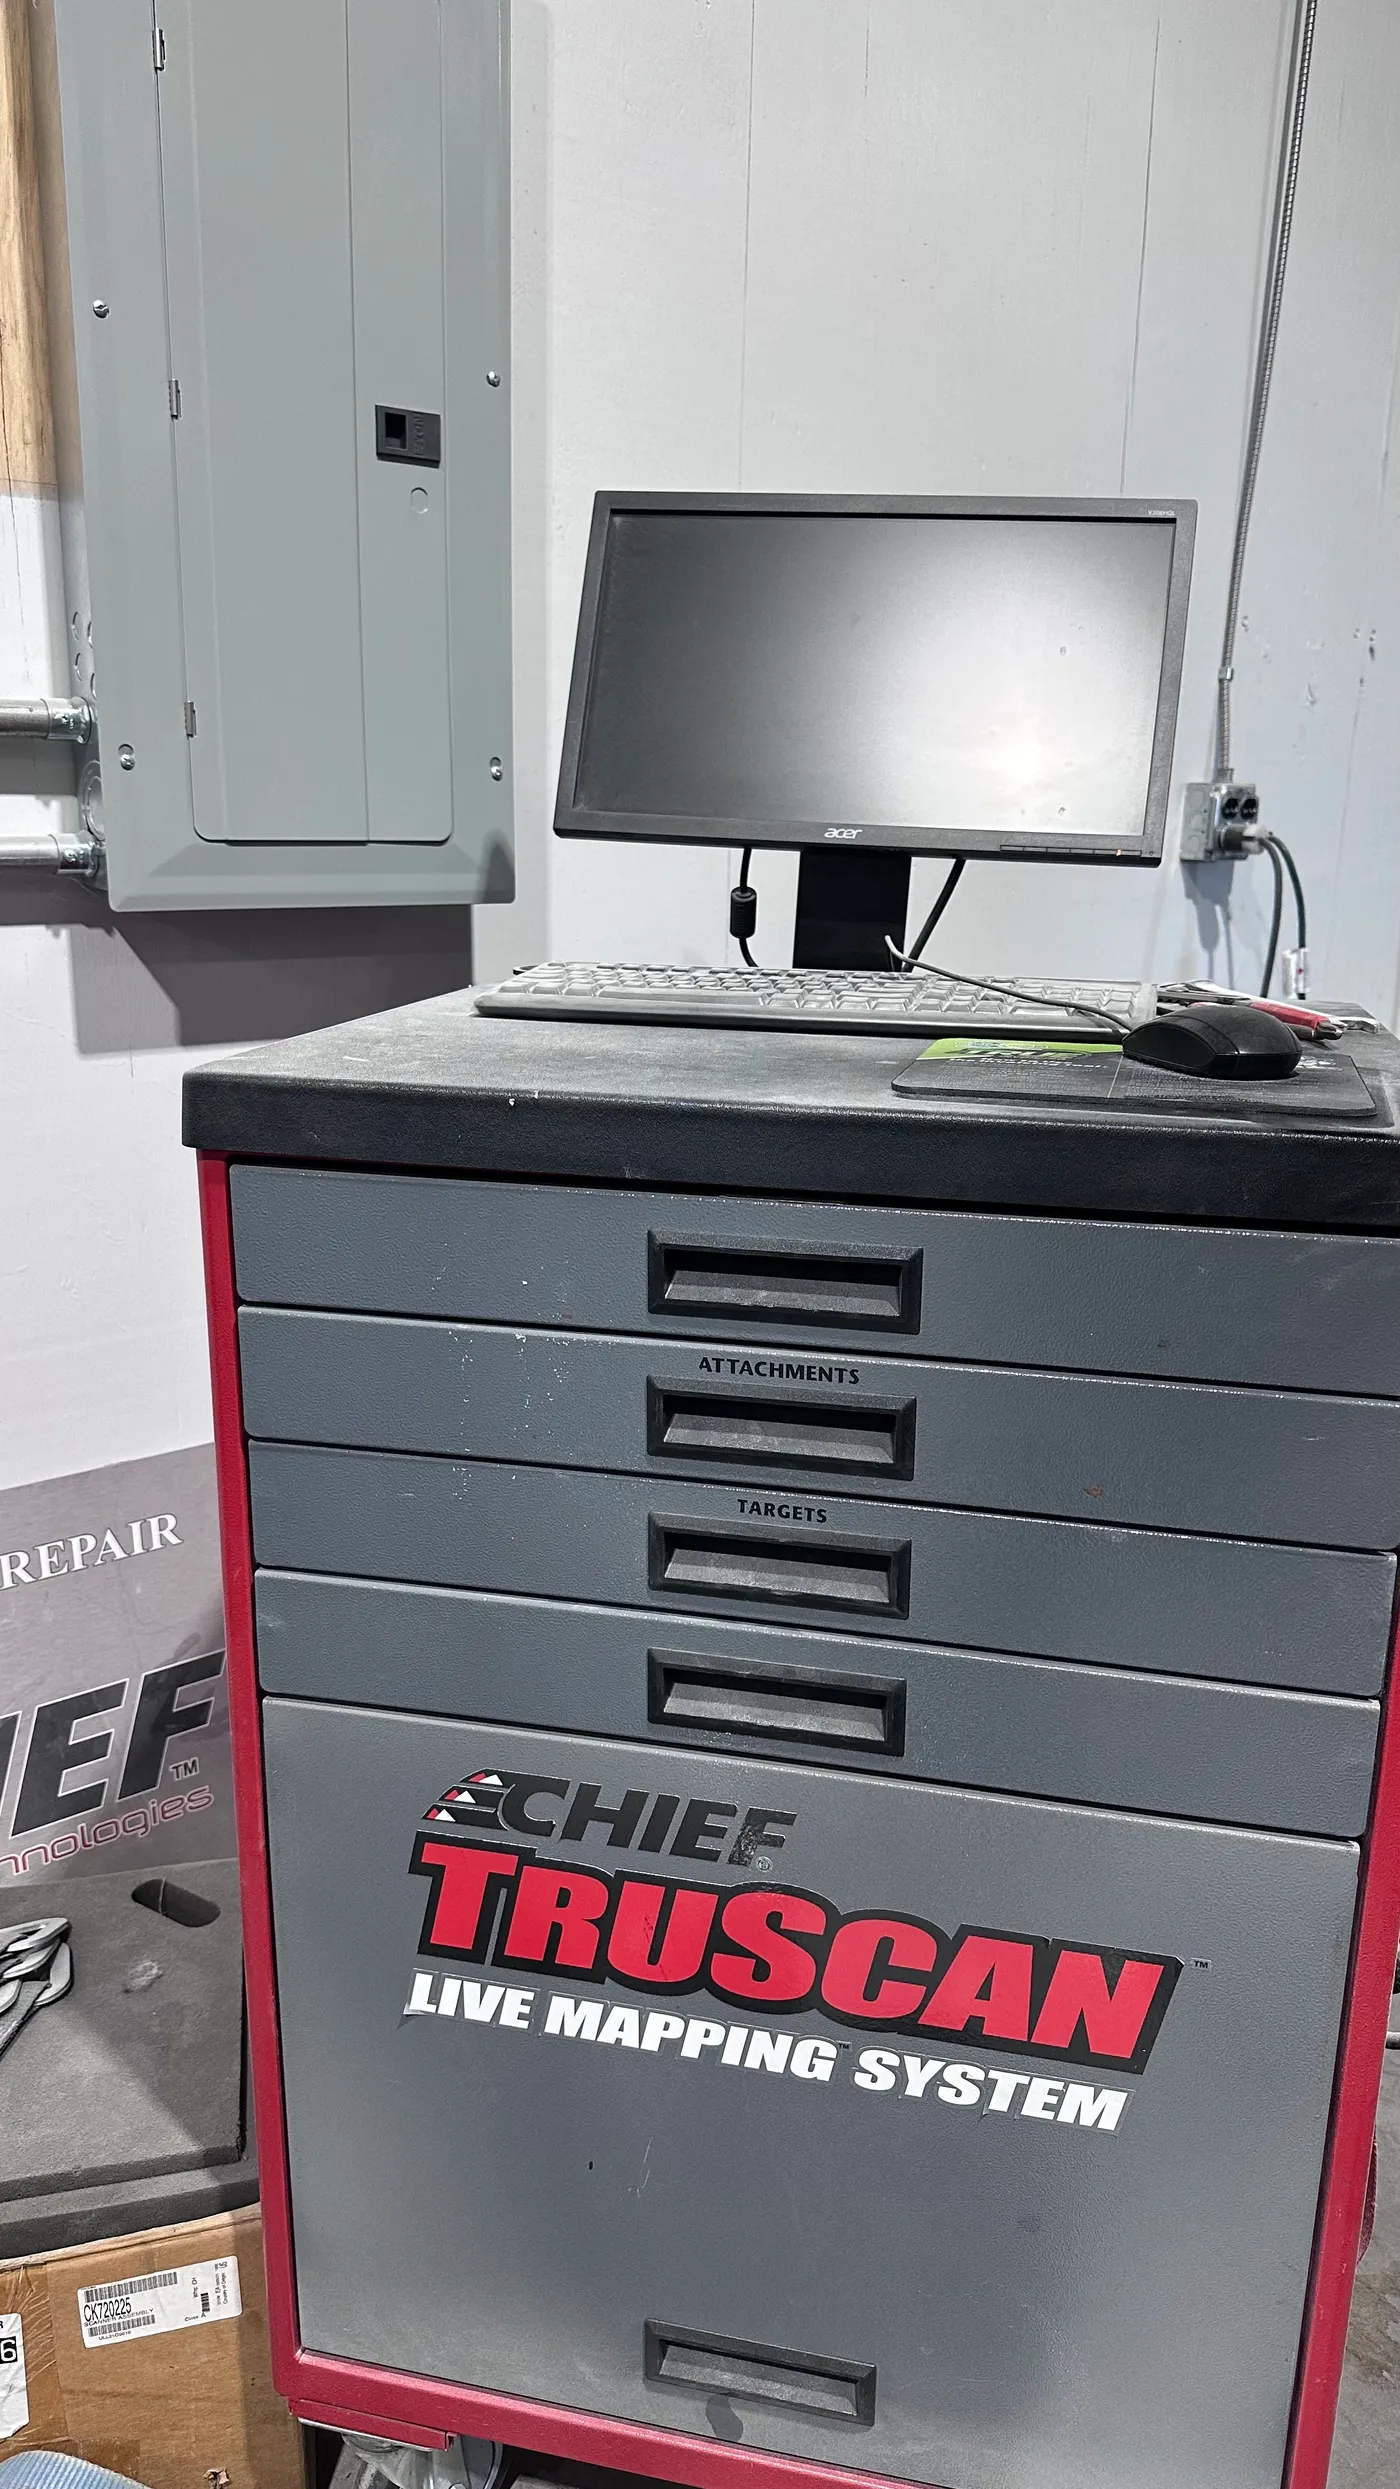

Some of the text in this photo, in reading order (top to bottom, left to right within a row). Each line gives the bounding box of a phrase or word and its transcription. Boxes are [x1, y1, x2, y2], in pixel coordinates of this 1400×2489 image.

[824, 828, 863, 839] acer
[699, 1357, 860, 1385] ATTACHMENTS
[737, 1499, 828, 1523] TARGETS
[0, 1512, 183, 1590] REPAIR
[0, 1648, 227, 1840] EF
[498, 1769, 798, 1866] CHIEF
[414, 1837, 1170, 2066] TRUSCAN
[408, 1972, 536, 2030] LIVE
[544, 1995, 839, 2083] MAPPING
[853, 2047, 1129, 2131] SYSTEM
[83, 2297, 132, 2322] CK720225
[83, 2308, 154, 2328] SCANNER ASSEMBLY
